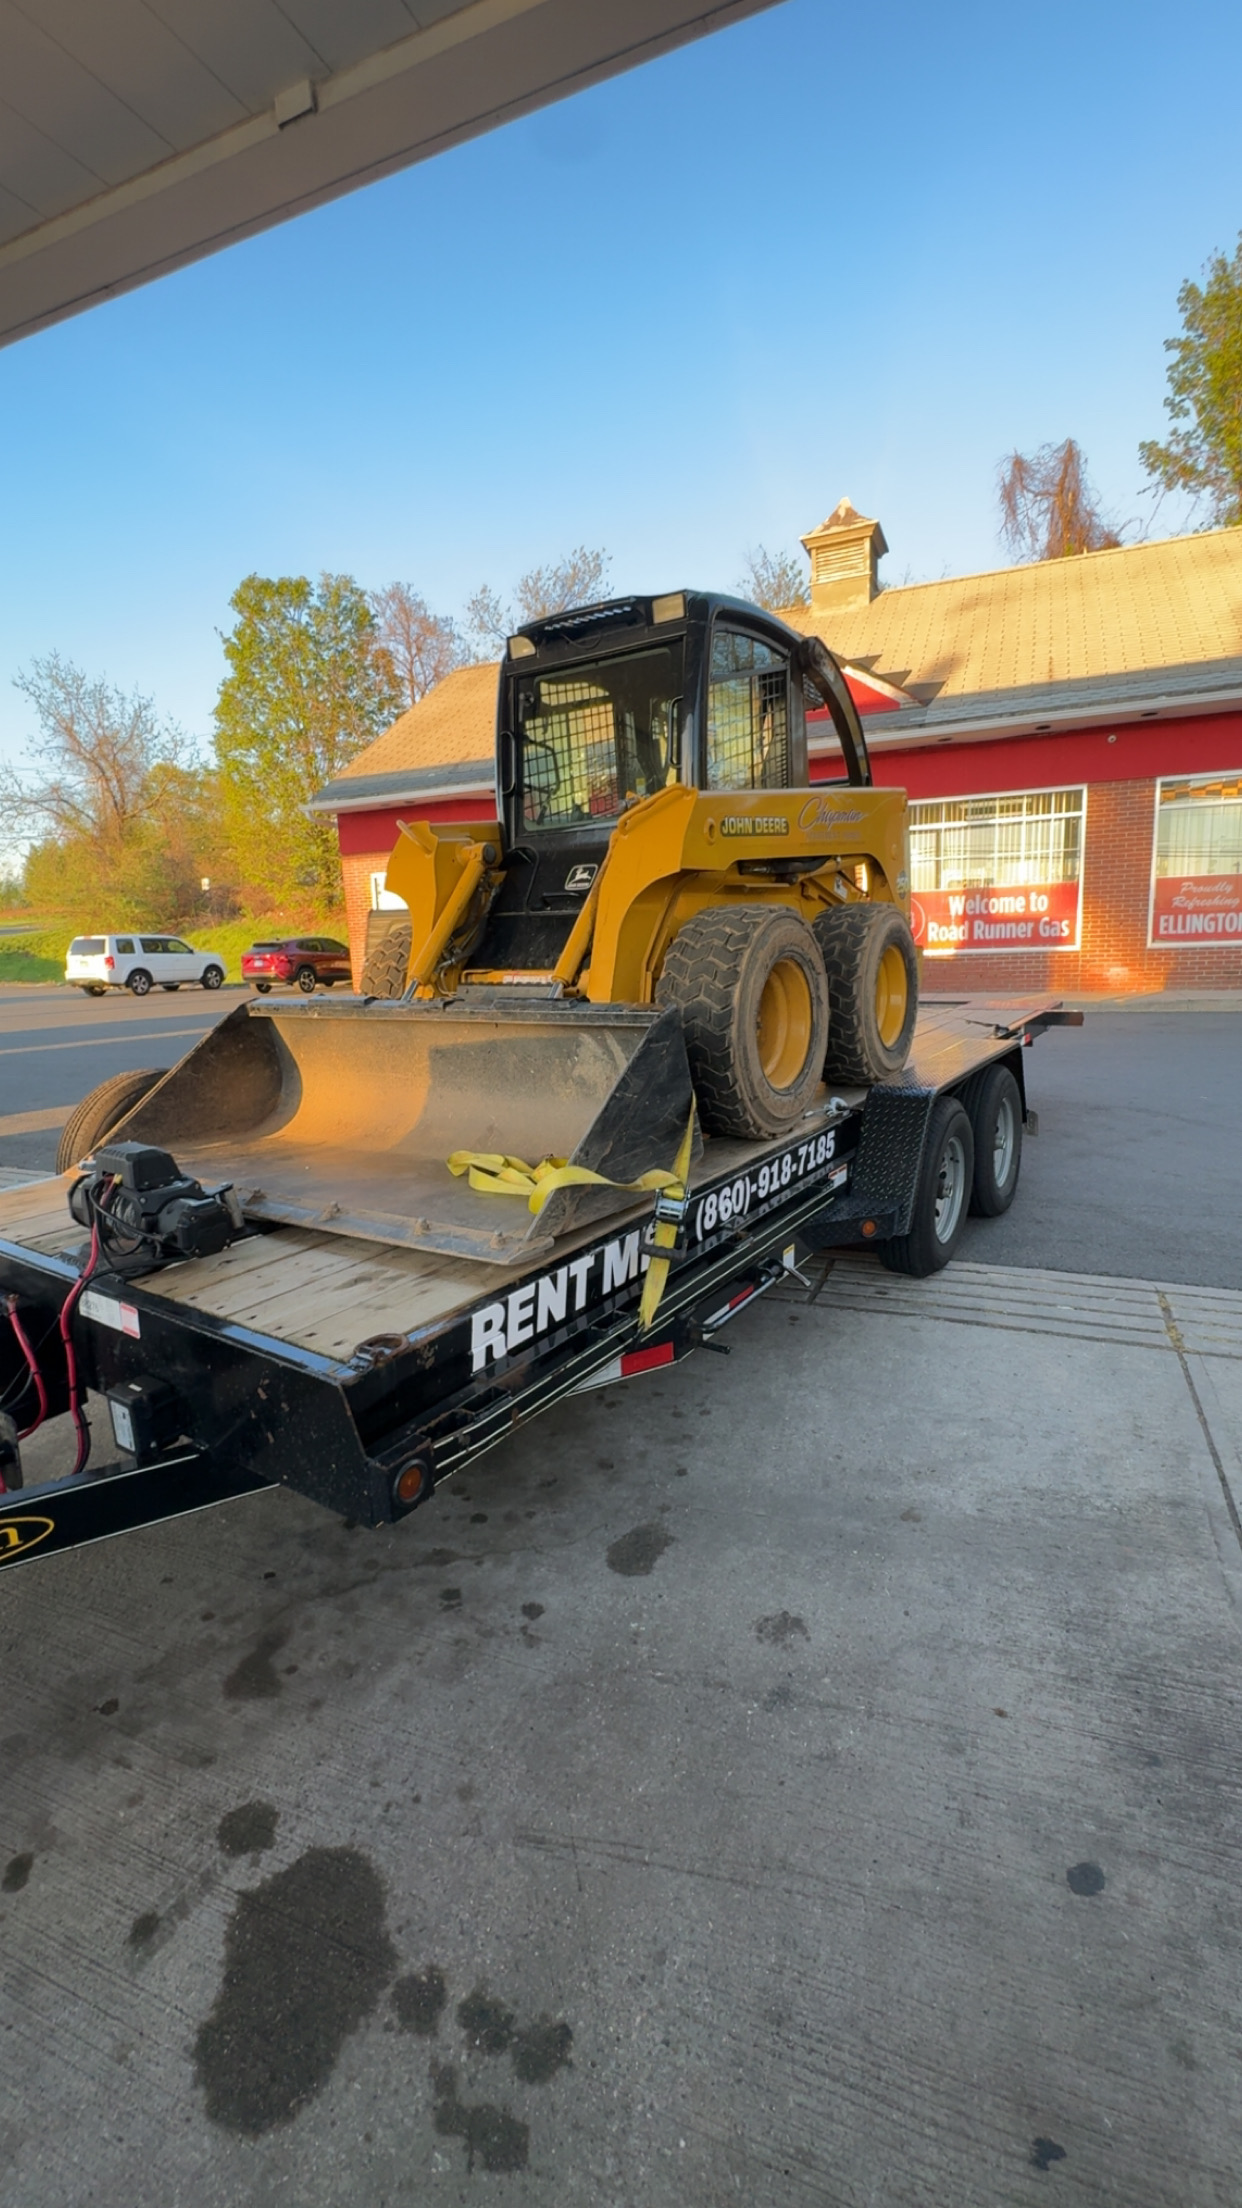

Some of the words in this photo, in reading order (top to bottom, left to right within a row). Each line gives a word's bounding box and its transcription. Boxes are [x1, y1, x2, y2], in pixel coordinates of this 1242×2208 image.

[722, 816, 753, 834] JOHN
[755, 816, 787, 833] DEERE
[1180, 881, 1234, 894] Proudly
[948, 894, 1026, 916] Welcome
[1029, 892, 1049, 912] to
[1171, 895, 1240, 911] Refreshing
[927, 921, 969, 942] Road
[973, 919, 1034, 940] Runner
[1039, 917, 1070, 937] Gas
[471, 1256, 594, 1373] RENT
[696, 1130, 836, 1242] (860)-918-7185
